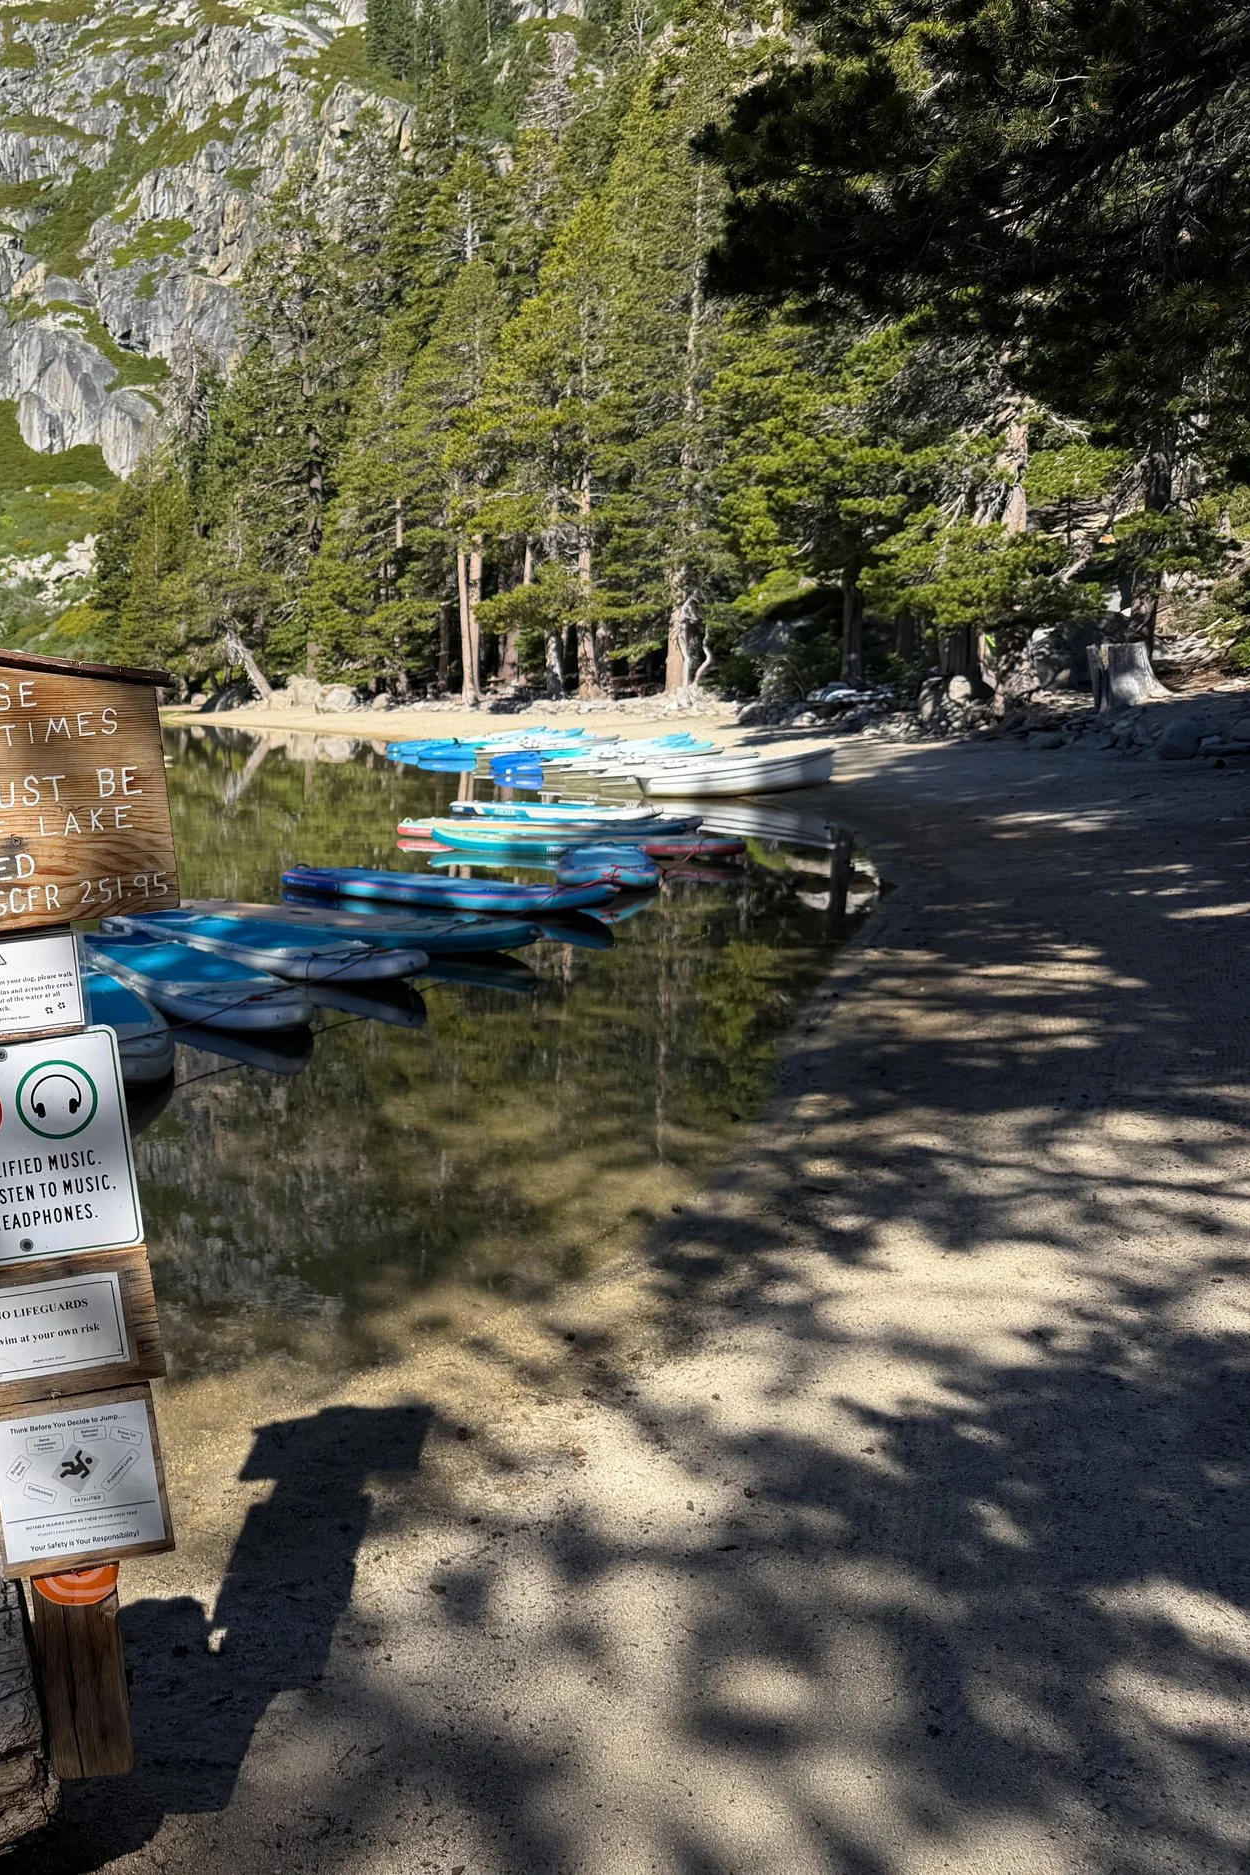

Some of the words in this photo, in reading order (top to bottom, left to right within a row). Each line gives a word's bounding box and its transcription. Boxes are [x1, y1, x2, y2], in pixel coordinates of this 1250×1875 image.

[97, 766, 142, 798] BE
[40, 805, 133, 837] LAKE
[79, 871, 169, 905] 251.95
[6, 978, 21, 986] your
[37, 974, 57, 982] please
[56, 981, 75, 989] creek.
[49, 1149, 102, 1171] MUSIC.
[39, 1181, 57, 1199] TO
[62, 1174, 117, 1196] MUSIC,
[13, 1298, 89, 1318] LIFEGUARDS
[20, 1334, 30, 1343] at
[32, 1330, 55, 1344] your
[57, 1328, 78, 1337] own
[80, 1322, 101, 1333] risk
[10, 1427, 29, 1435] Think
[29, 1423, 52, 1432] Before
[67, 1418, 90, 1427] Decide
[47, 1540, 68, 1549] Safety
